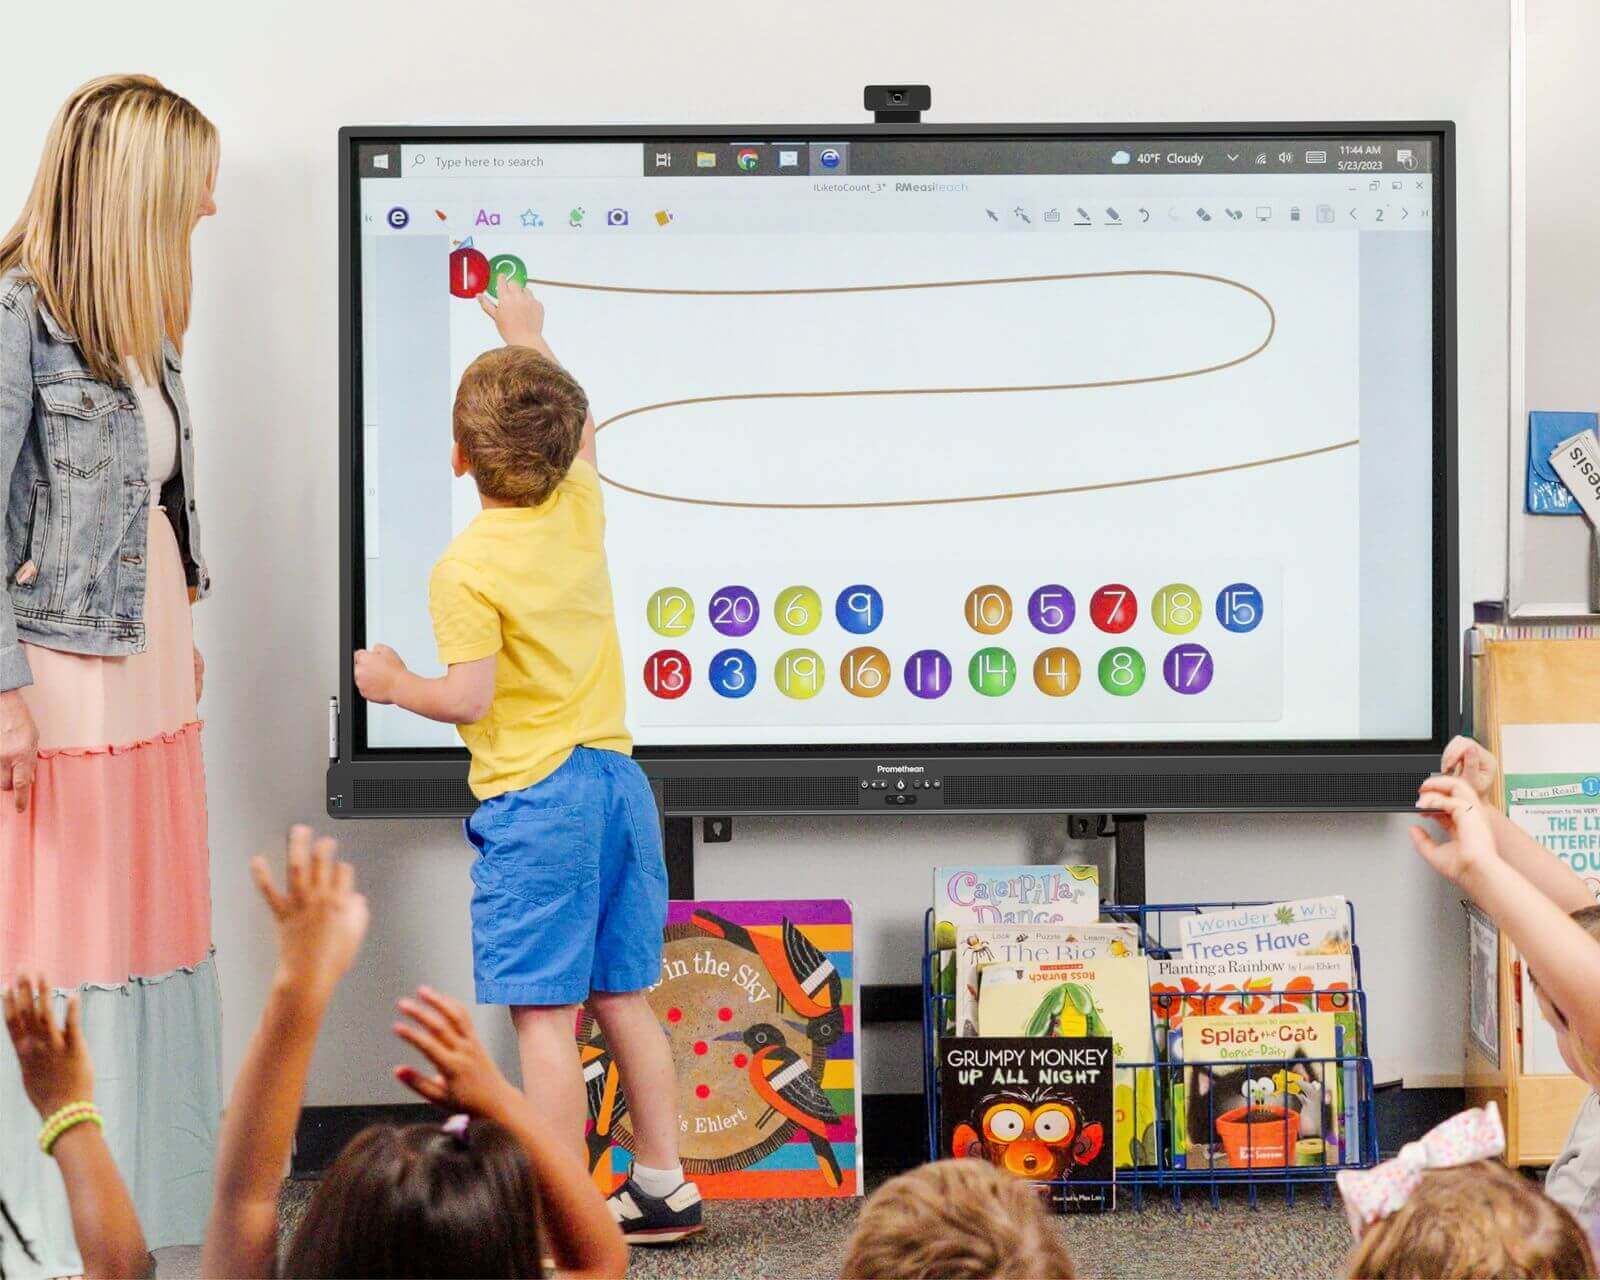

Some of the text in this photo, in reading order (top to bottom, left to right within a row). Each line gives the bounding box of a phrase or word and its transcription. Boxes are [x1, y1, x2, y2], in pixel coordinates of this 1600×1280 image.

[1137, 152, 1204, 165] 40°F Cloudy
[1340, 145, 1382, 155] 11:44 AM
[434, 156, 544, 169] Type here to search
[1337, 160, 1383, 171] 5/23/2023
[475, 208, 500, 226] Aa
[1375, 208, 1384, 222] 2
[656, 590, 1255, 630] 12 20 6 9 10 5 7 18 15
[653, 652, 1207, 692] 13 3 19 16 11 14 4 8 17
[876, 765, 924, 774] Promethean
[1531, 790, 1550, 798] Can
[1547, 816, 1577, 831] THE
[1559, 852, 1600, 872] OU
[972, 904, 1064, 925] Dance
[1199, 910, 1269, 933] Wonder
[1300, 902, 1338, 917] Why
[1036, 932, 1061, 940] Puzzle
[1000, 944, 1049, 962] The
[1186, 931, 1310, 960] Trees Have
[662, 950, 771, 1003] in the Sky
[1029, 971, 1095, 983] Ross Burach
[1159, 961, 1216, 977] Planting
[1217, 965, 1226, 974] a
[1228, 959, 1285, 974] Rainbow
[1200, 1025, 1318, 1046] Splat the Cat
[947, 1048, 1109, 1067] GRUMPY MONKEY
[958, 1068, 1101, 1085] UP ALL NIGHT
[695, 1107, 748, 1134] Ehlert
